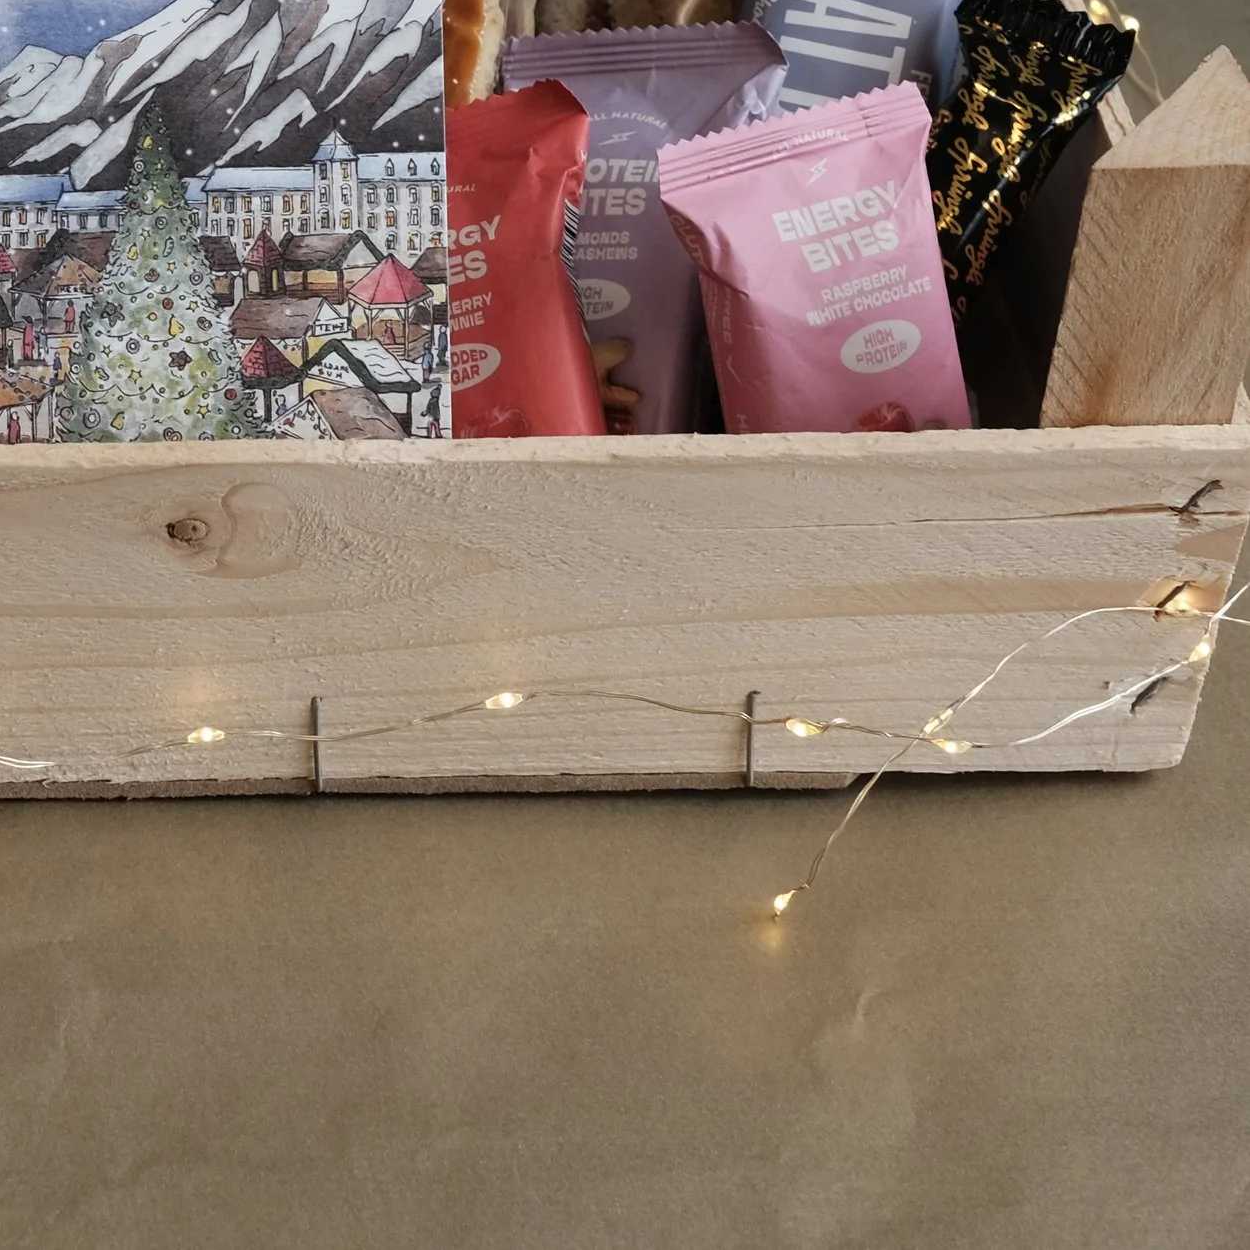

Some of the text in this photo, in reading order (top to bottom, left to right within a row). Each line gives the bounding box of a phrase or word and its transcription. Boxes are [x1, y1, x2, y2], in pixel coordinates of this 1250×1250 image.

[611, 110, 668, 130] NATURAL
[579, 187, 647, 216] ITES
[771, 180, 899, 242] ENERGY
[576, 230, 630, 245] MONDS
[800, 220, 900, 273] BITES
[821, 265, 908, 303] RASPBERRY
[806, 300, 852, 327] WHITE
[854, 276, 932, 312] CHOCOLATE
[862, 327, 894, 346] HIGH
[451, 347, 489, 366] DDED
[855, 339, 908, 366] PROTEIN
